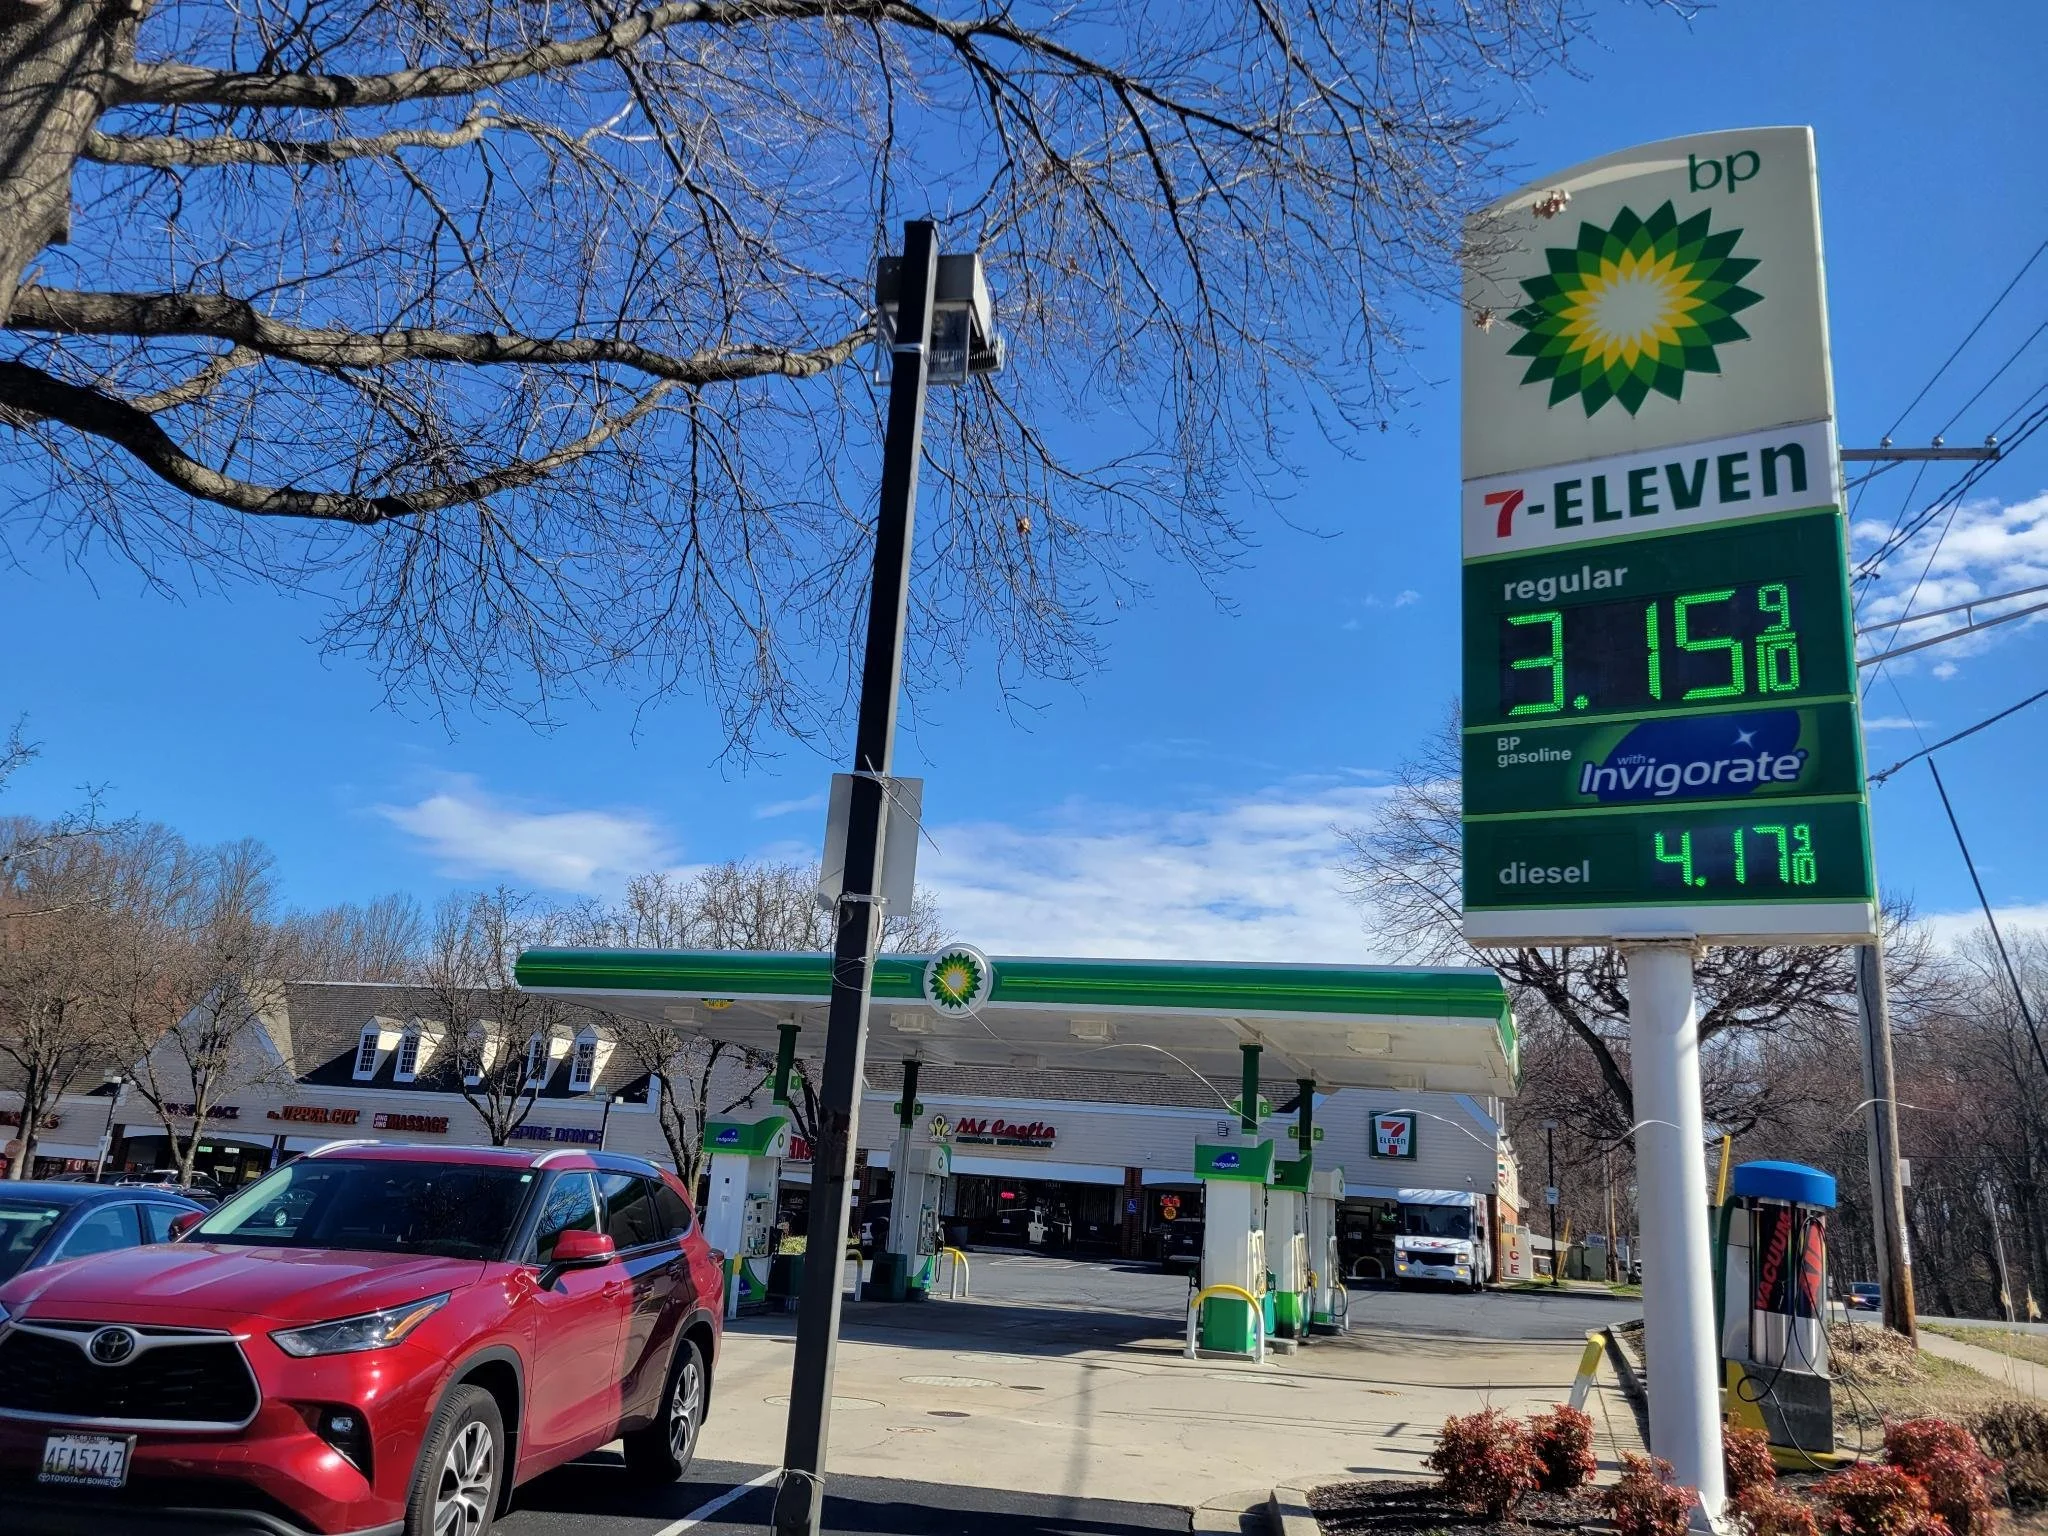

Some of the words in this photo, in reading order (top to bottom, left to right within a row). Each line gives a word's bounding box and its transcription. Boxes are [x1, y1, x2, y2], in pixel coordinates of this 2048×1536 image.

[1688, 149, 1761, 194] bp
[1503, 565, 1628, 603] regular
[1497, 737, 1521, 752] BP
[1497, 747, 1572, 768] gasoline
[1616, 753, 1647, 765] with
[1579, 750, 1800, 797] Invigorate
[1499, 860, 1591, 886] diesel
[1509, 1237, 1520, 1275] ICE
[1756, 1210, 1792, 1311] VACUUM
[51, 1474, 79, 1484] TOYOTA
[79, 1476, 87, 1484] of
